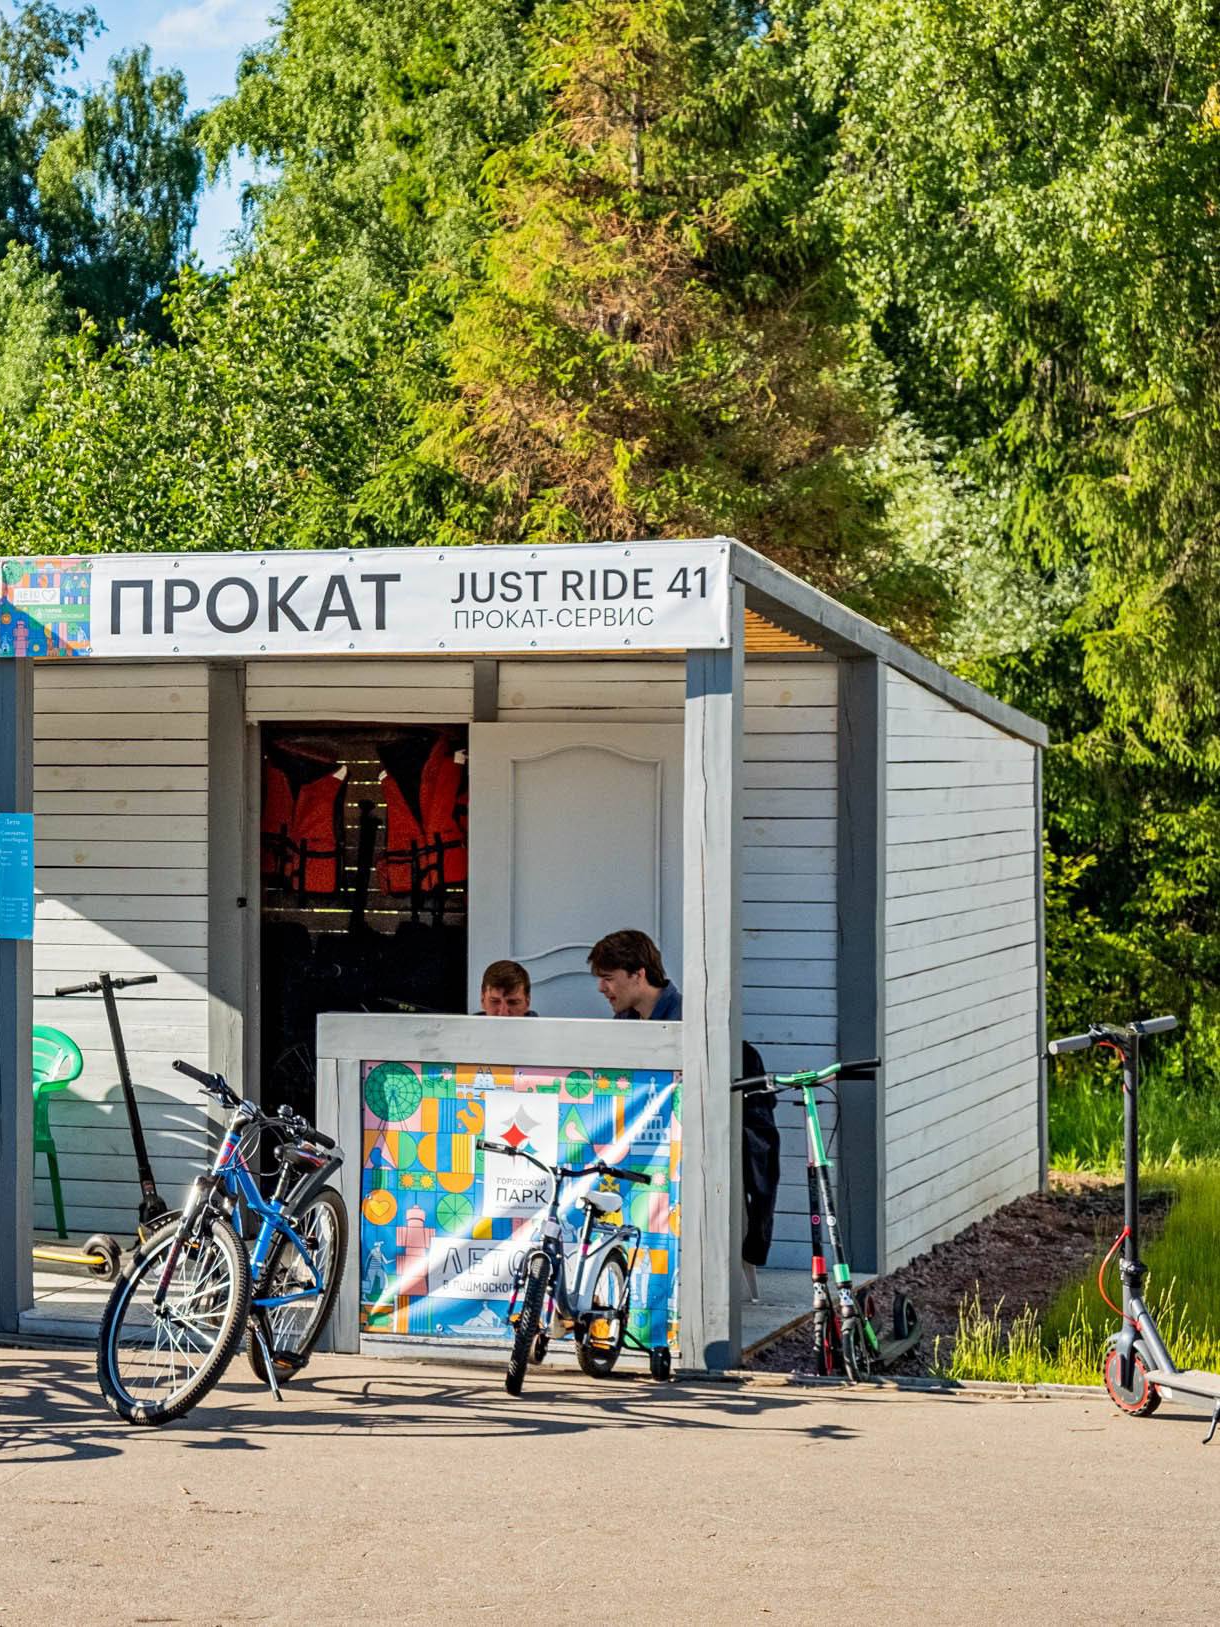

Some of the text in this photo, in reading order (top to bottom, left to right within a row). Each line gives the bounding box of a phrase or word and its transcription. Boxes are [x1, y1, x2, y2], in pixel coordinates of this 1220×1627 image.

[451, 566, 707, 604] JUST RIDE 41
[110, 573, 402, 635] ПРОКАТ
[454, 606, 654, 629] ПРОКАТ-СЕРВИС
[496, 1176, 547, 1186] ГОРОДСКОЙ
[496, 1187, 549, 1205] ПАРК
